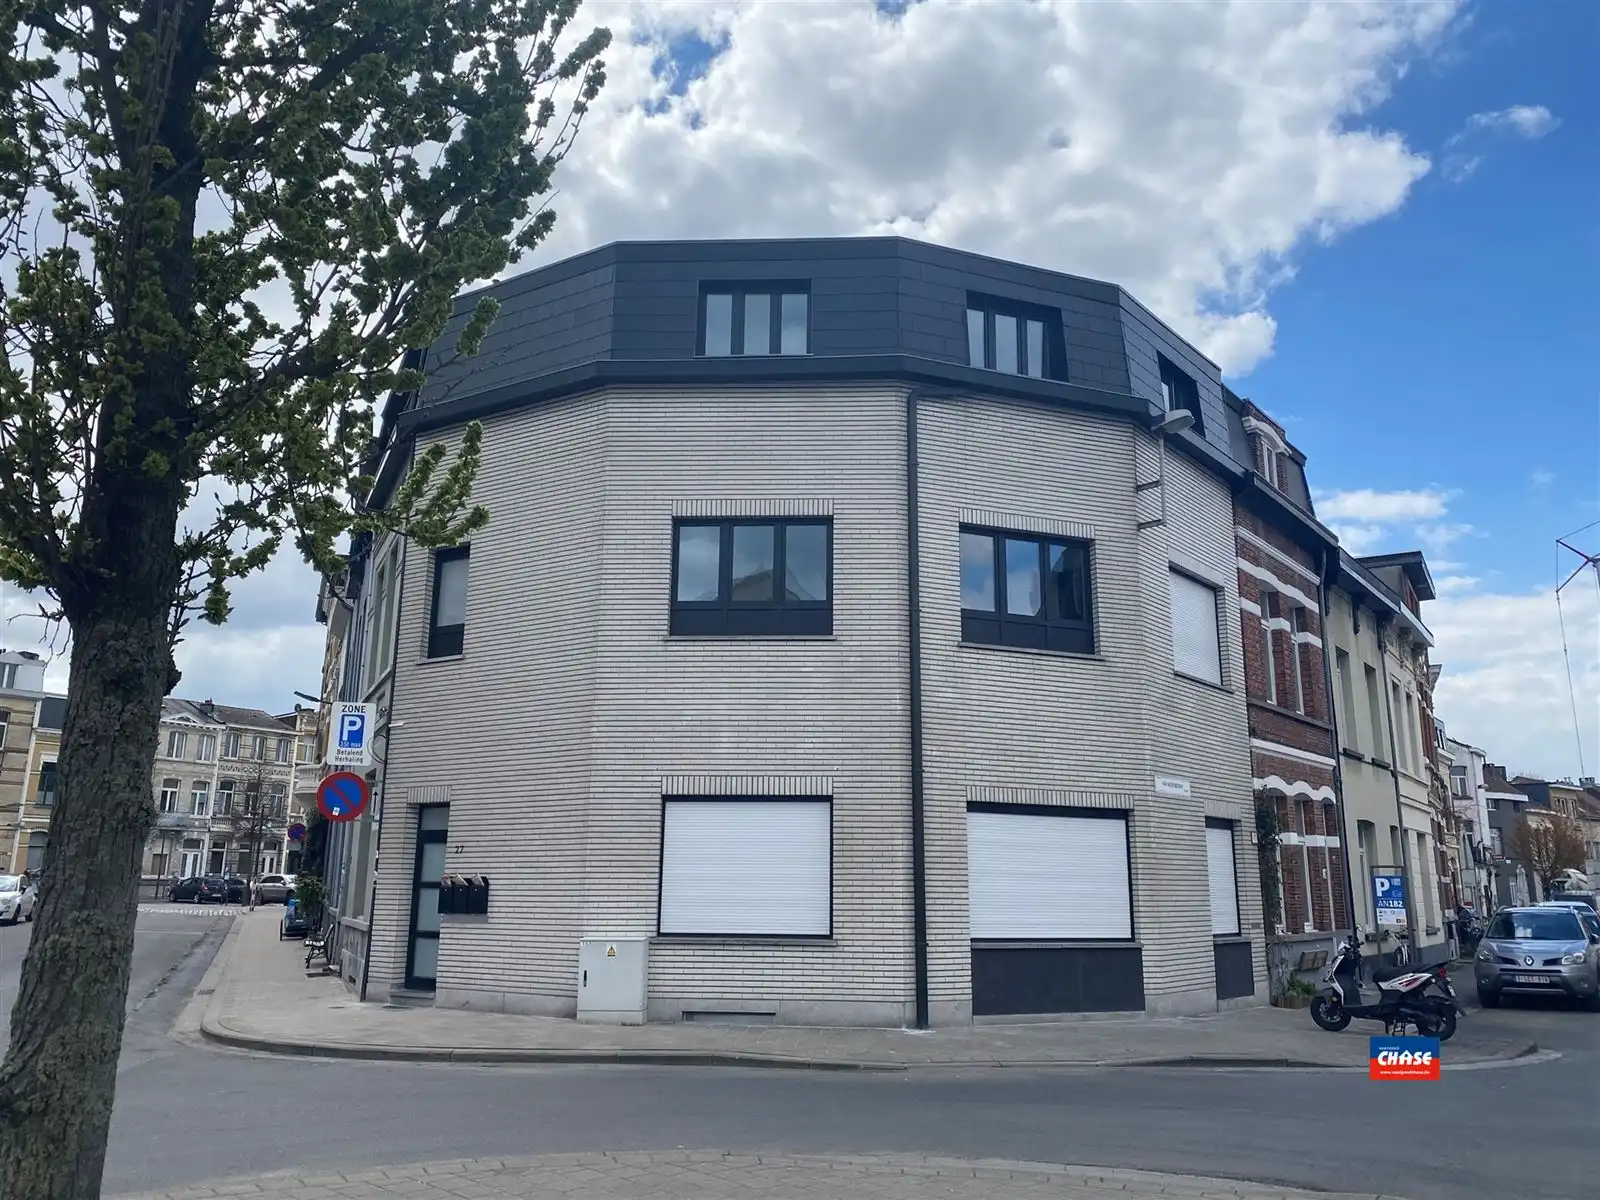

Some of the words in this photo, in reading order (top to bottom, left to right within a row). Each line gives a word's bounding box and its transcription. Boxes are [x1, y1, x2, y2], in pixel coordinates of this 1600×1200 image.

[342, 705, 366, 713] ZONE
[342, 716, 361, 741] P
[455, 845, 464, 853] 27
[1375, 878, 1390, 897] P
[1378, 900, 1403, 908] AN182
